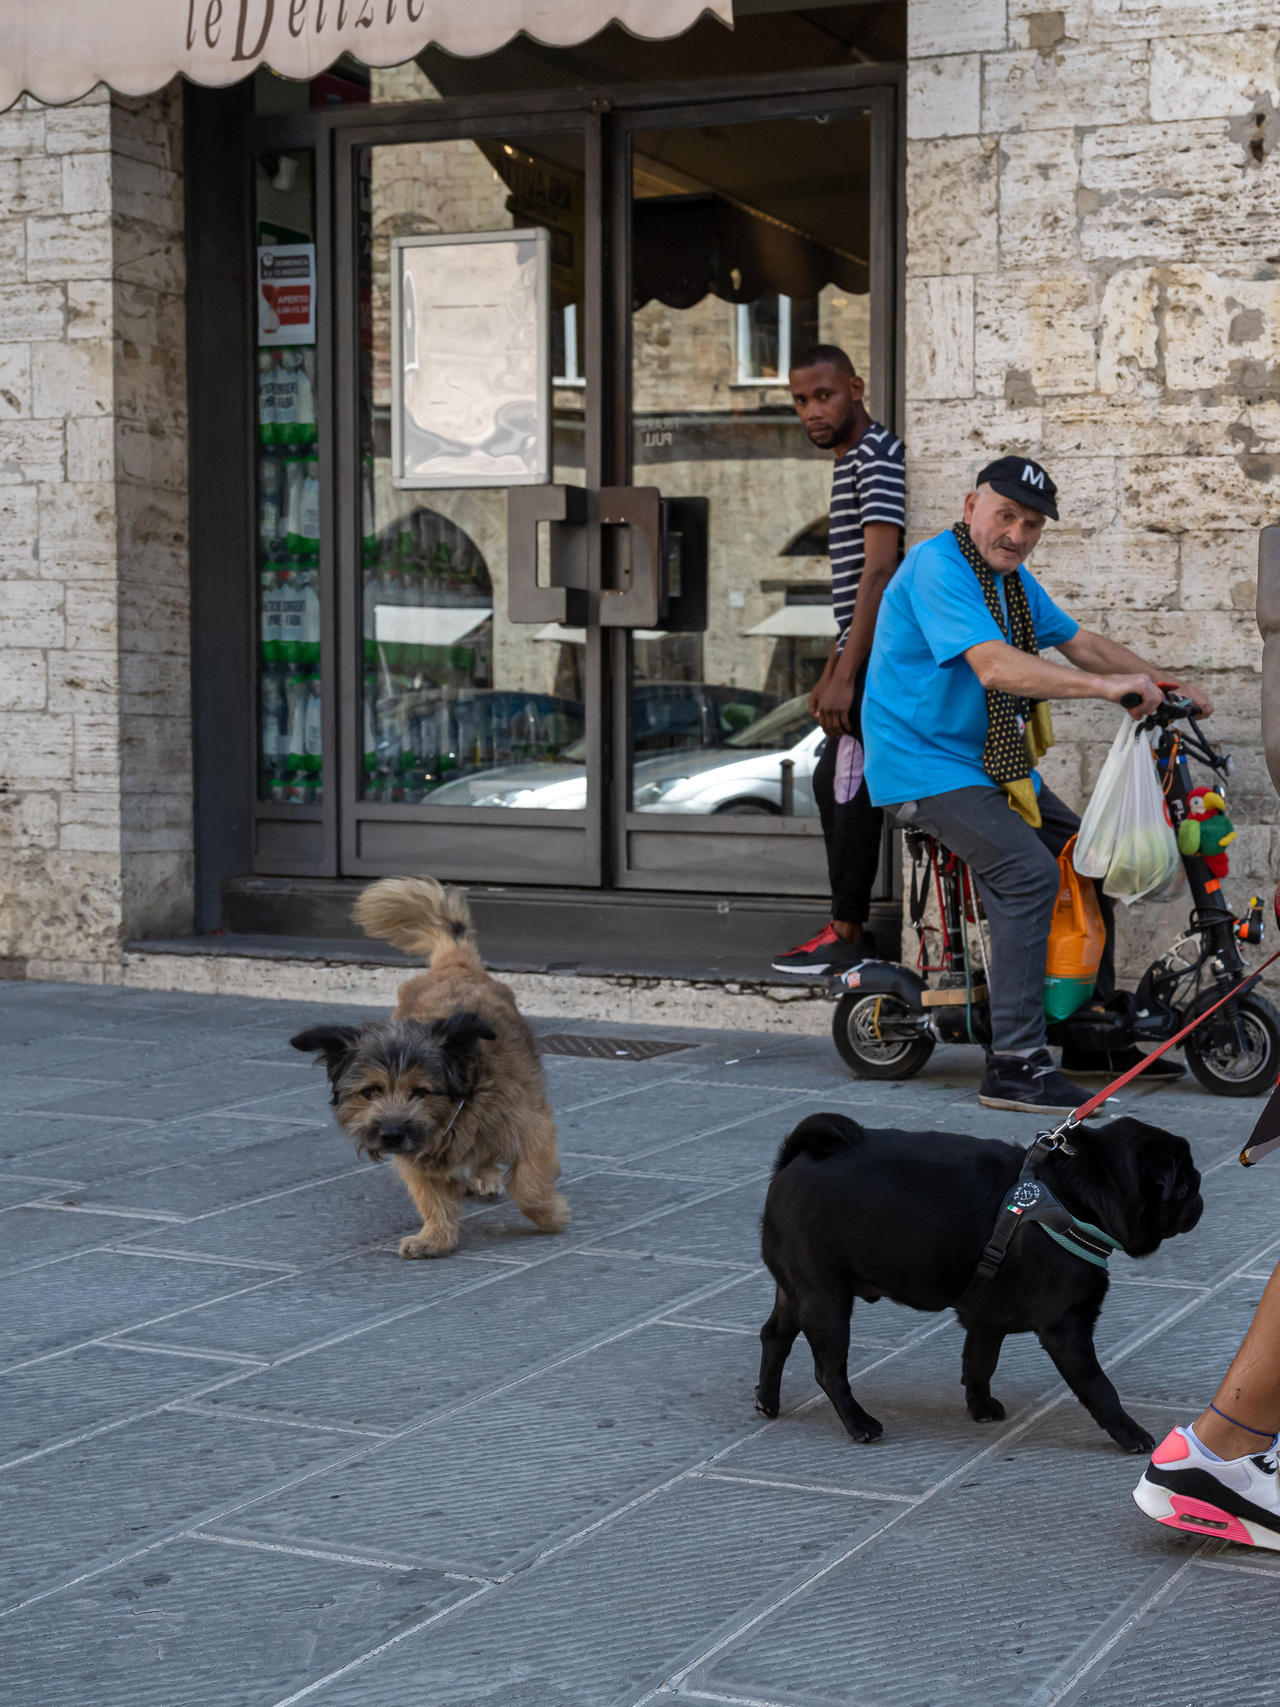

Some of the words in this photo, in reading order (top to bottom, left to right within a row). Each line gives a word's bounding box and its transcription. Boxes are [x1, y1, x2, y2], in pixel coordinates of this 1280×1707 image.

[231, 0, 425, 61] Deliz
[278, 295, 309, 304] APERTO
[1021, 464, 1045, 490] M
[1171, 799, 1186, 824] FL
